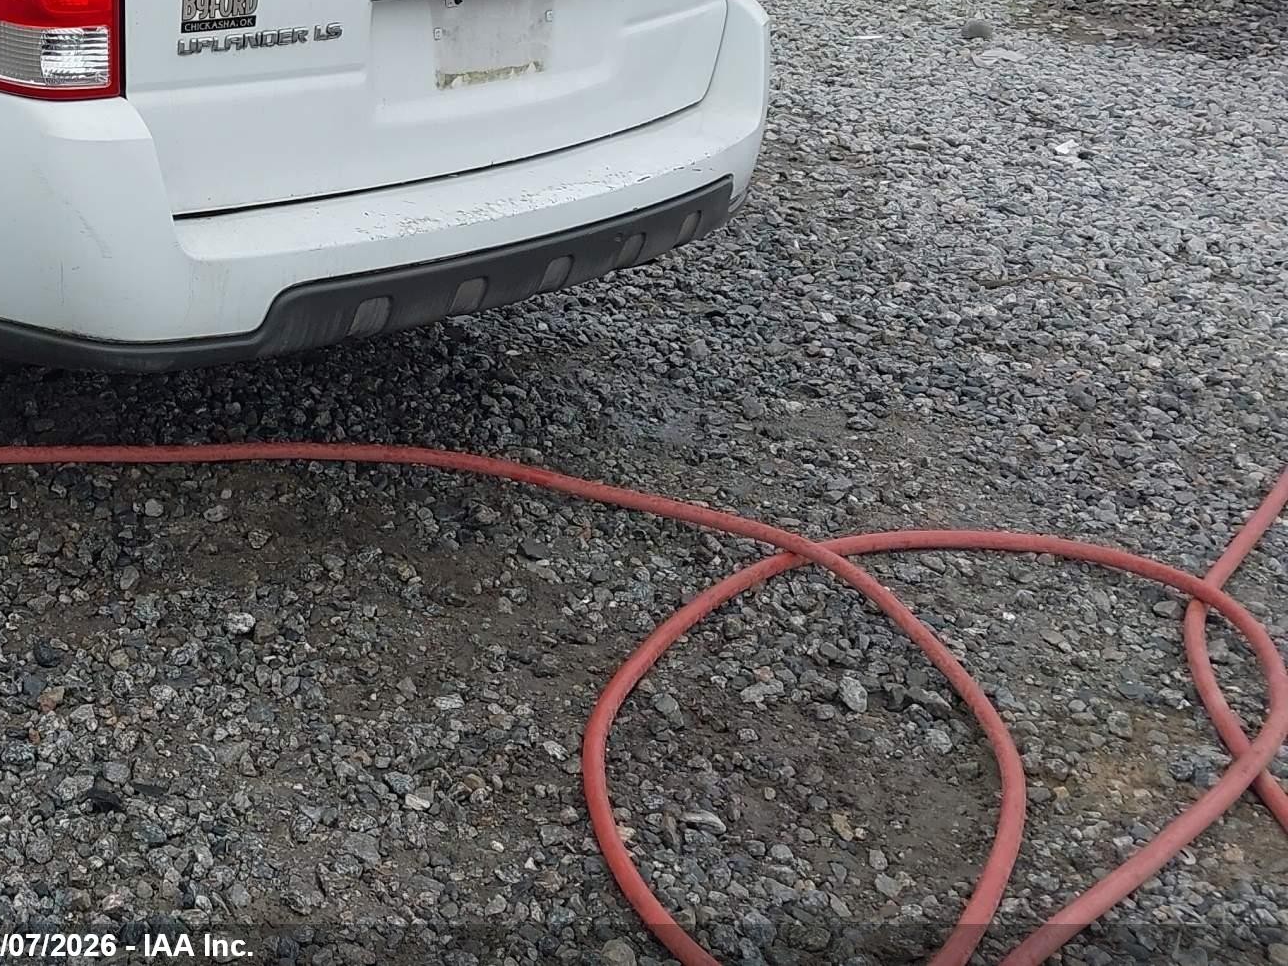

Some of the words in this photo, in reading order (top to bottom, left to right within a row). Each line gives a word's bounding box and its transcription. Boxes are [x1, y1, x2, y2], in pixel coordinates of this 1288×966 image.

[239, 17, 254, 28] OK
[177, 27, 309, 56] UPLANDER
[314, 22, 343, 42] LS
